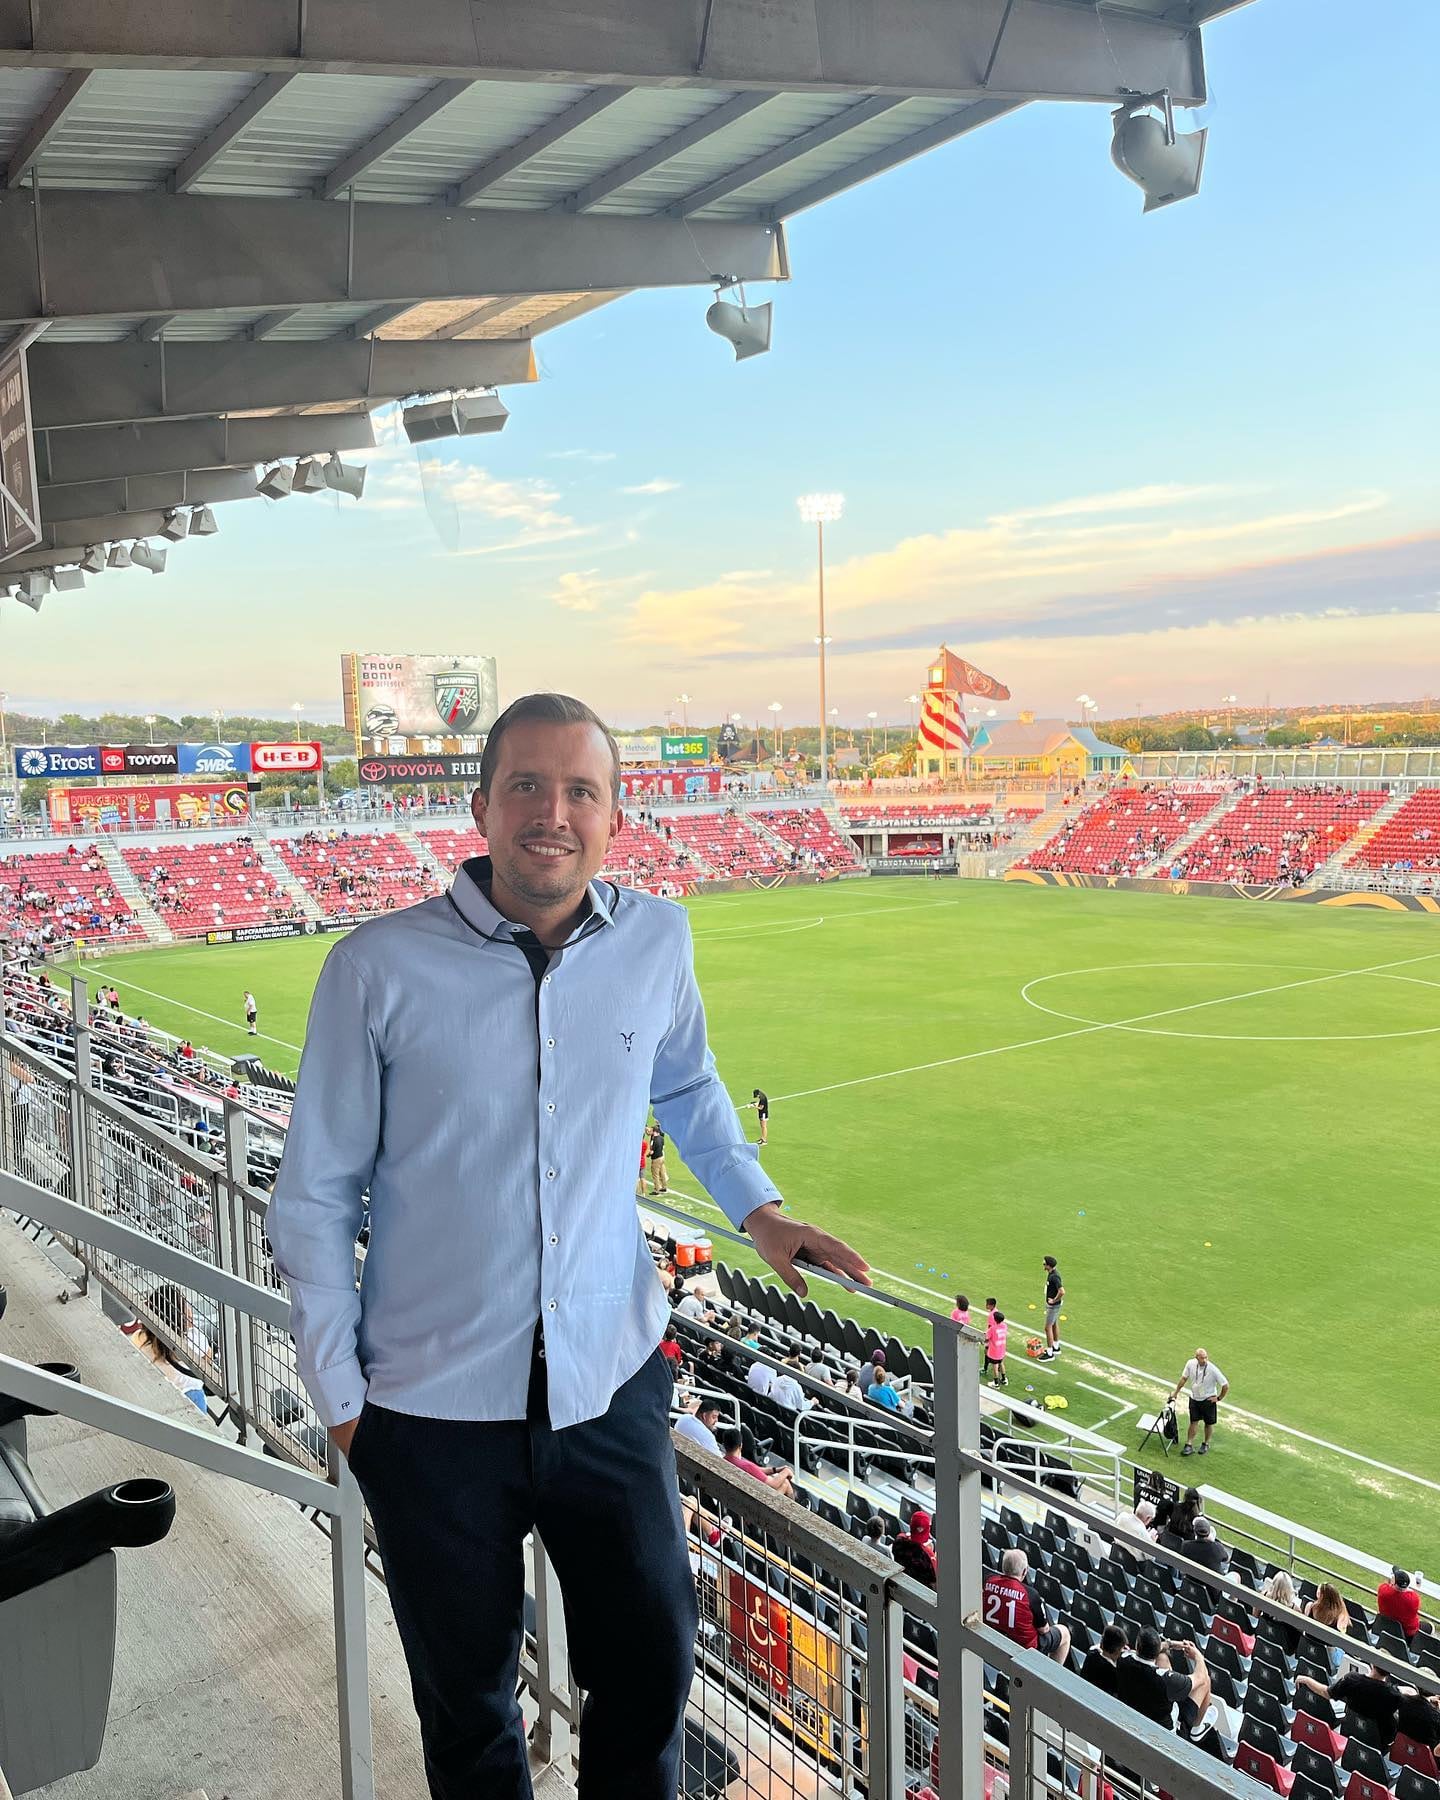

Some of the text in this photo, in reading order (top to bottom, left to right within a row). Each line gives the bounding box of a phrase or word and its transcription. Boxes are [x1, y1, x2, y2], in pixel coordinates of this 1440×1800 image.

[362, 672, 392, 680] BONI
[665, 743, 703, 755] bet365
[50, 753, 96, 771] Frost
[128, 755, 176, 766] TOYOTA
[195, 759, 234, 772] SWBC
[388, 763, 445, 777] TOYOTA
[71, 793, 151, 807] BURGERTCA
[868, 818, 963, 827] CAPTAIN'S CORNER
[909, 859, 944, 867] TAILGAE
[341, 1401, 350, 1410] FP
[985, 1582, 1025, 1601] SAFC FAMILY
[986, 1594, 1016, 1628] 21
